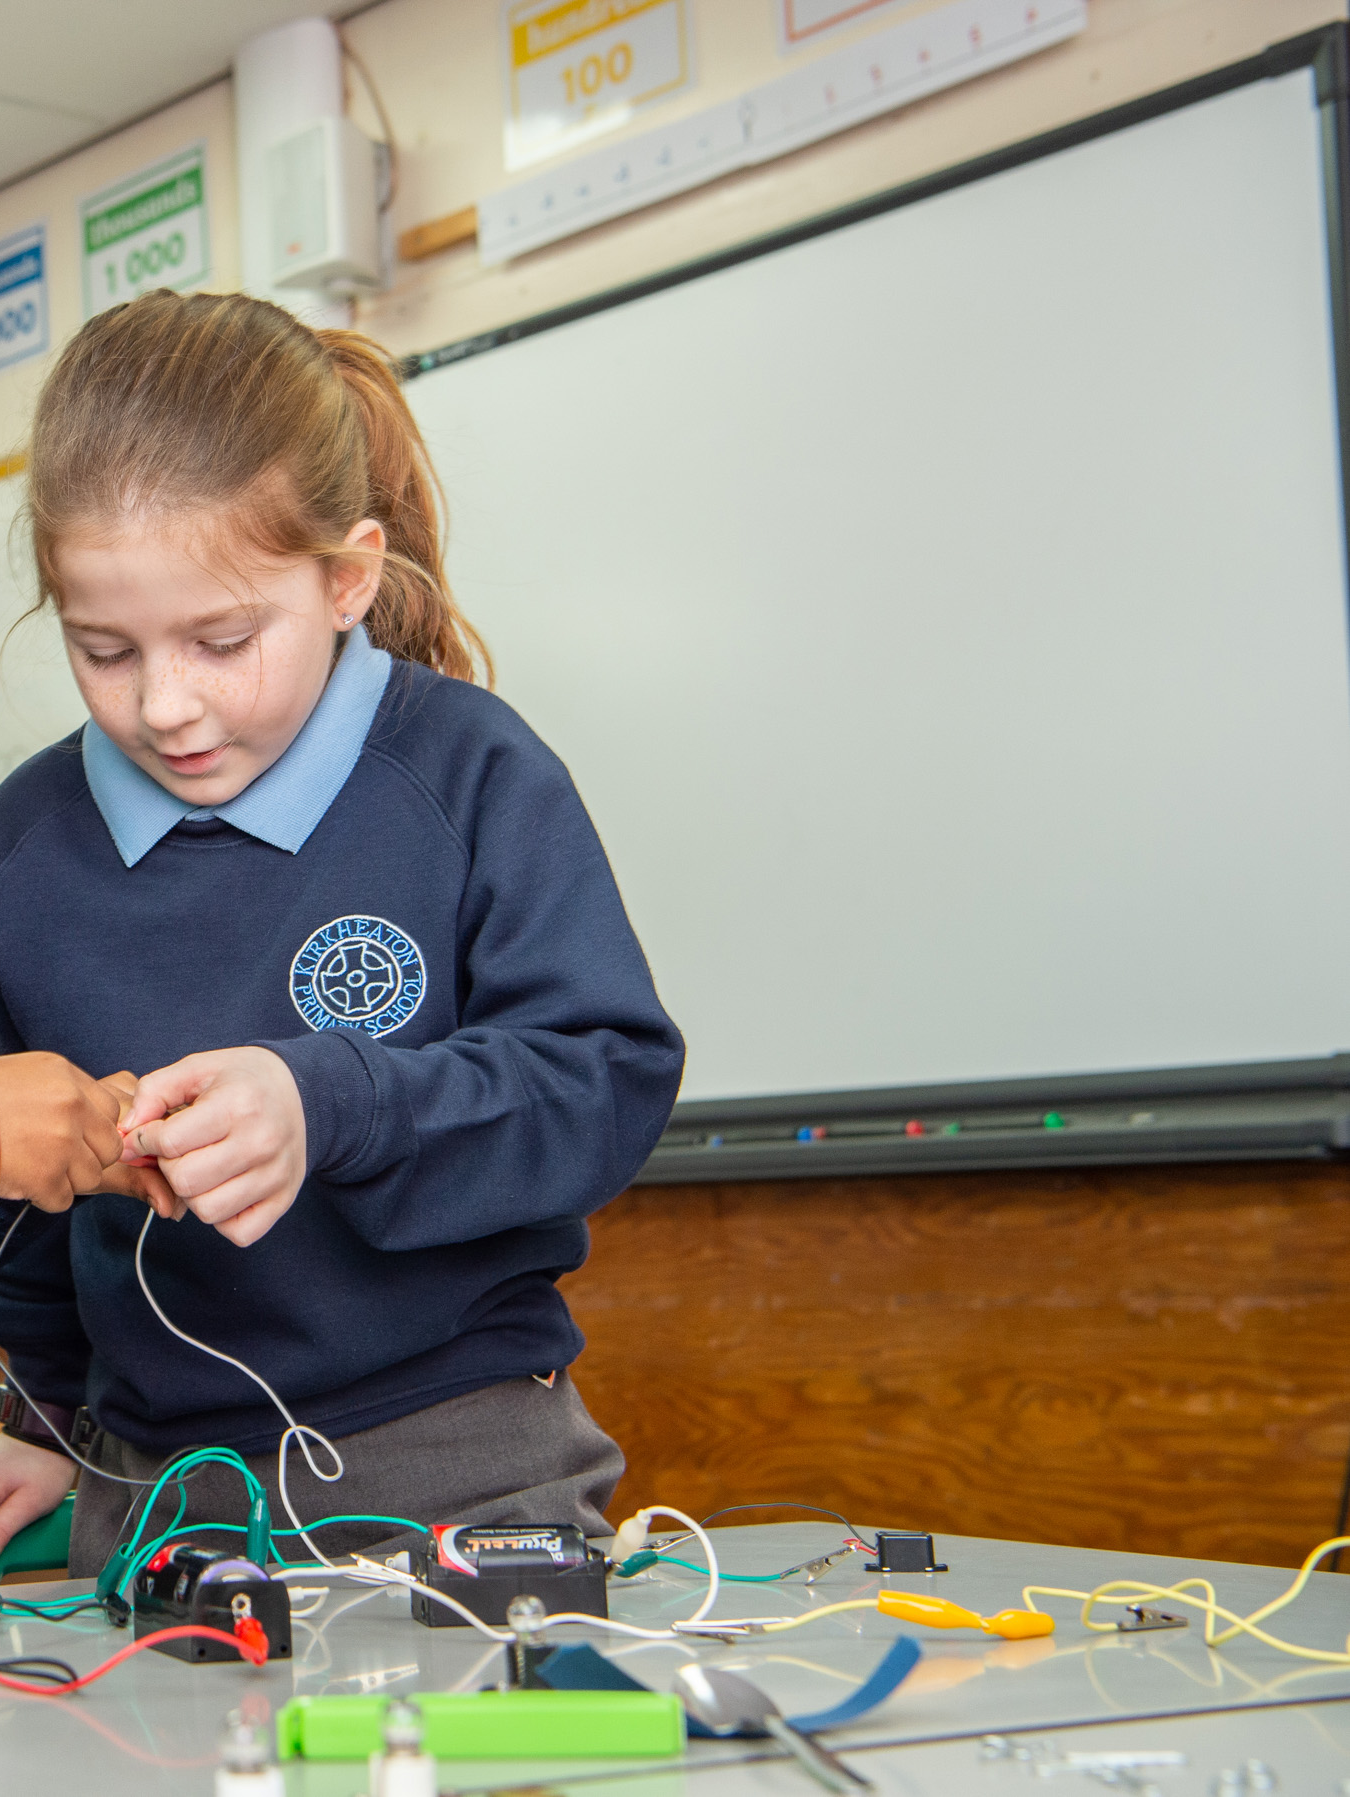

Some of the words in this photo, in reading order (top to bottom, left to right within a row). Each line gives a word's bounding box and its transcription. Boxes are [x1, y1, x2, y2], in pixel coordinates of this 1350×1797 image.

[561, 42, 633, 106] 100
[105, 261, 118, 296] 1
[125, 231, 187, 285] 000
[294, 919, 419, 977] KIRKHEATON
[364, 970, 423, 1036] SCHOOL
